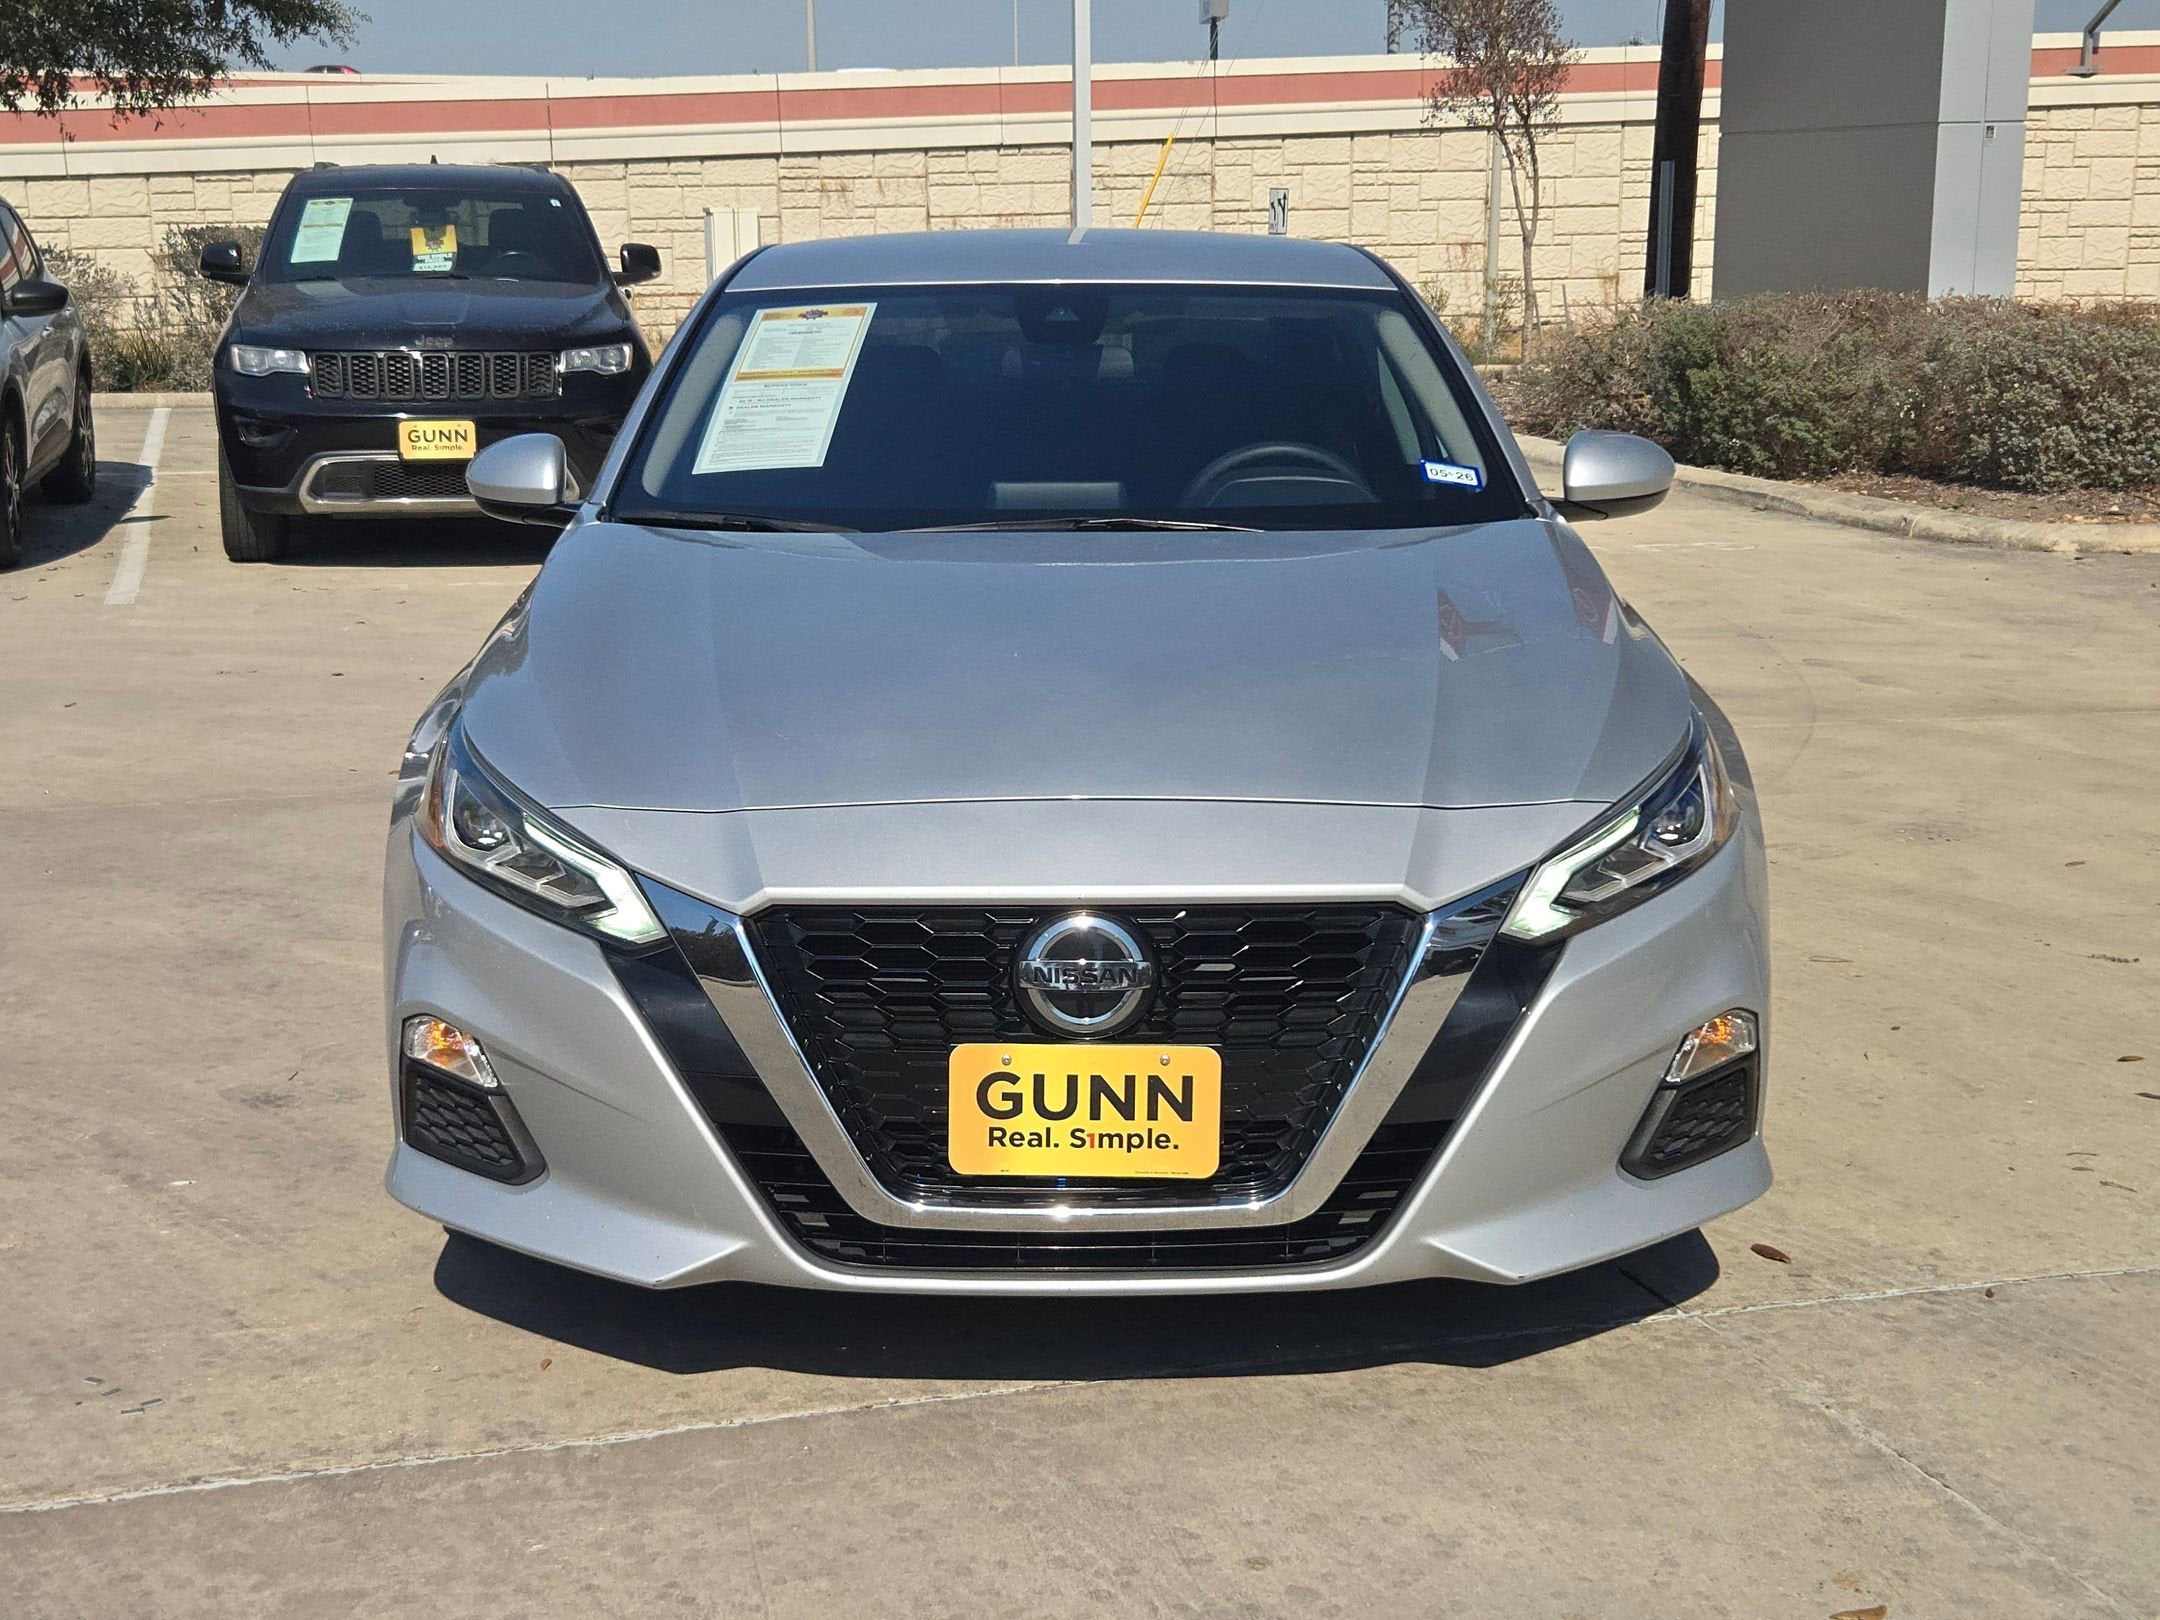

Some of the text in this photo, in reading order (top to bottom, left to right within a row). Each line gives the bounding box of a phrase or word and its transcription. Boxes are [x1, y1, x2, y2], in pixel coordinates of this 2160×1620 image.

[414, 334, 454, 348] Jeep
[407, 429, 468, 443] GUNN
[1033, 965, 1138, 985] NISSAN
[976, 1071, 1194, 1122] GUNN
[988, 1127, 1059, 1148] Real.
